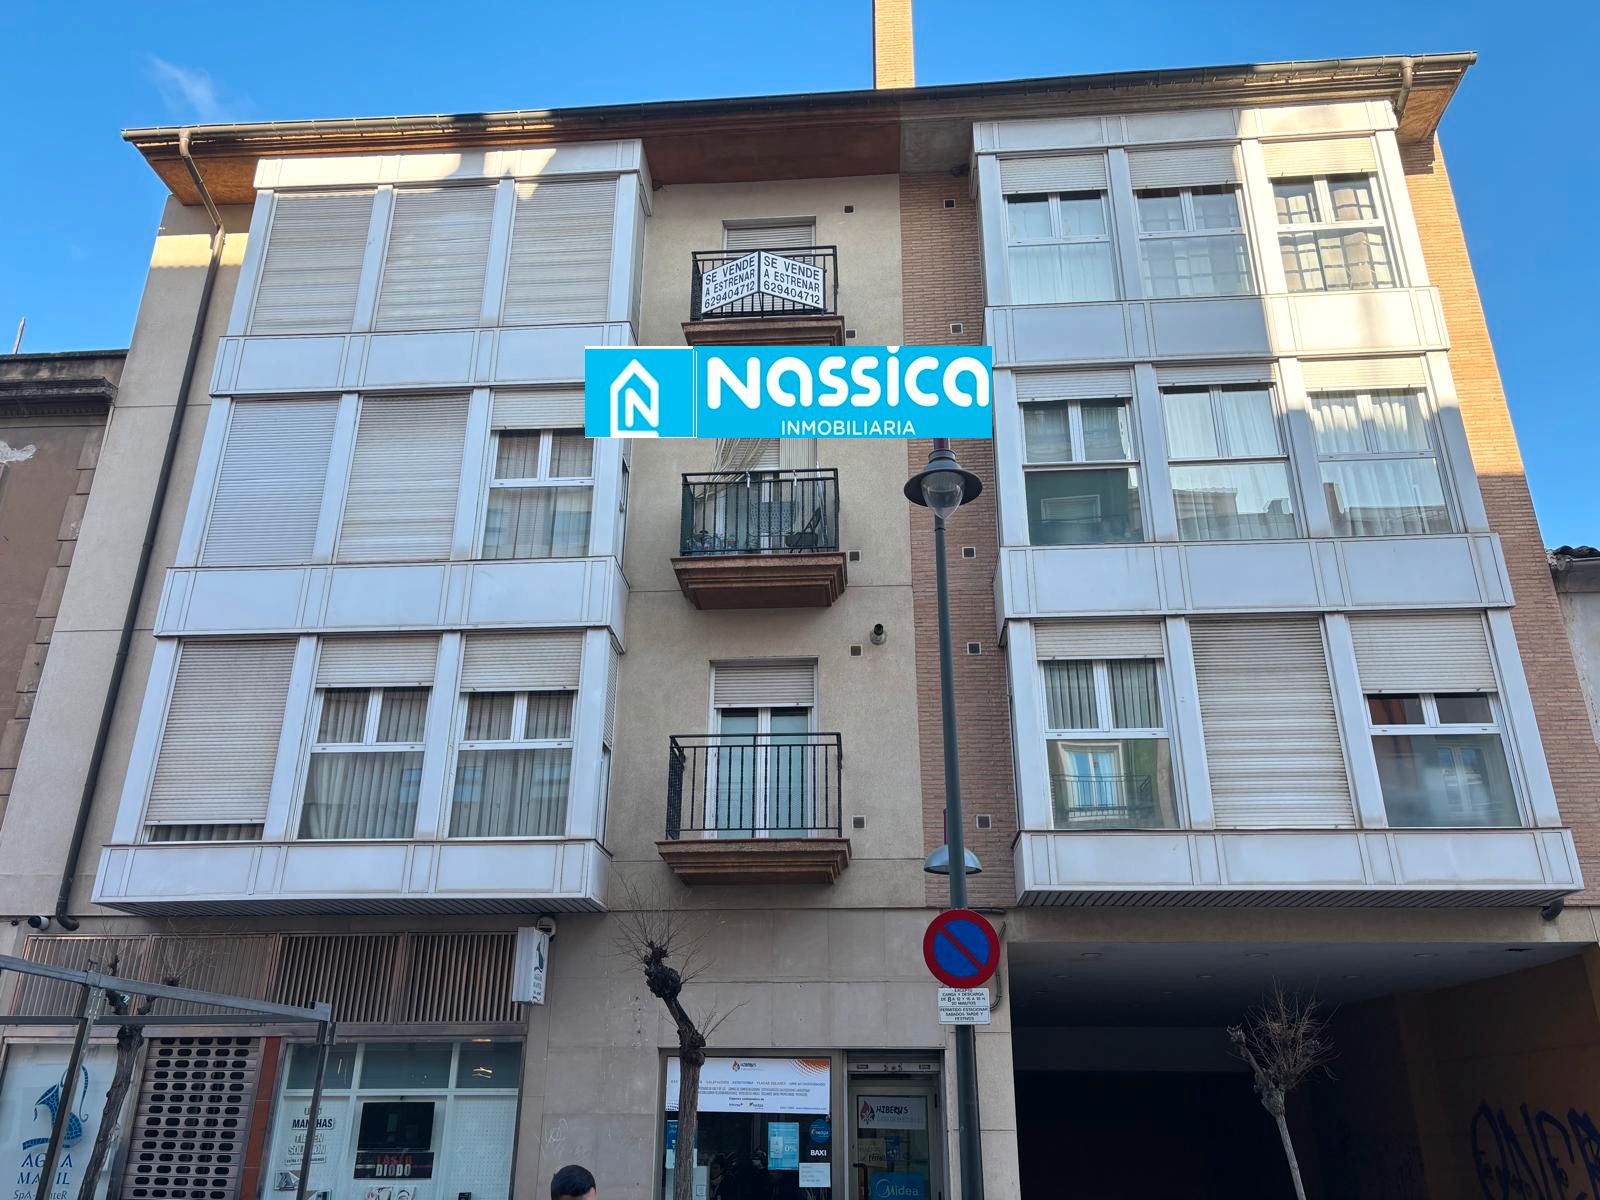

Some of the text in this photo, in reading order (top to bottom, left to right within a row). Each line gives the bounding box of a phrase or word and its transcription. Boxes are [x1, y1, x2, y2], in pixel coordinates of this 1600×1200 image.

[705, 256, 755, 285] SE VENDE
[764, 255, 820, 281] SE VENDE
[704, 269, 755, 297] A ESTRENAR
[764, 270, 820, 293] A ESTRENAR
[704, 281, 755, 309] 629404712
[764, 280, 820, 305] 629404712
[876, 1106, 909, 1115] HIBERUS
[292, 1118, 333, 1128] MANHAS
[21, 1152, 73, 1168] AGA
[17, 1172, 70, 1184] MAIL
[376, 1164, 411, 1176] DIODO
[880, 1181, 919, 1197] Midea
